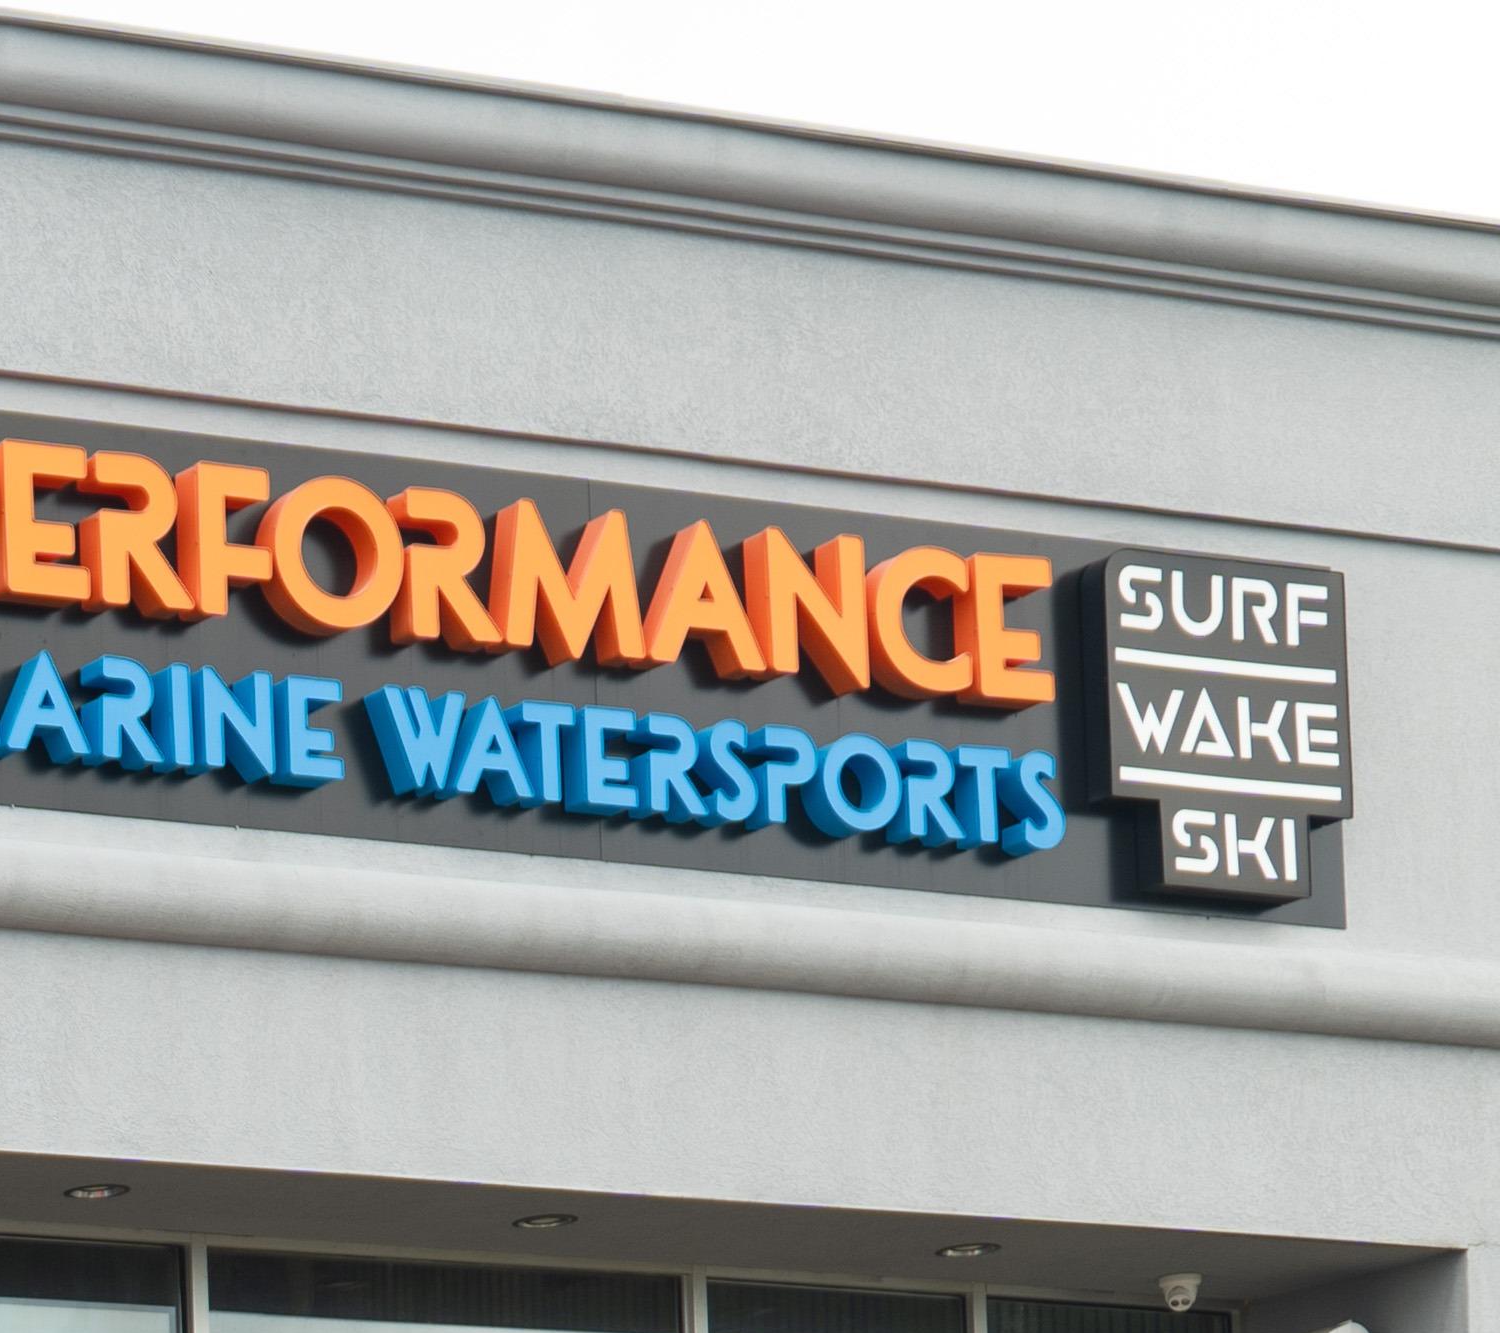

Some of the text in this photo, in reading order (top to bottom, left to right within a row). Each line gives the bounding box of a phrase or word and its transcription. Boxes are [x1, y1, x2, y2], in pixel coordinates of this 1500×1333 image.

[1117, 566, 1330, 649] SURF
[1117, 681, 1342, 769] WAKE
[364, 682, 1067, 857] WATERSPORTS
[1172, 809, 1301, 882] SKI
